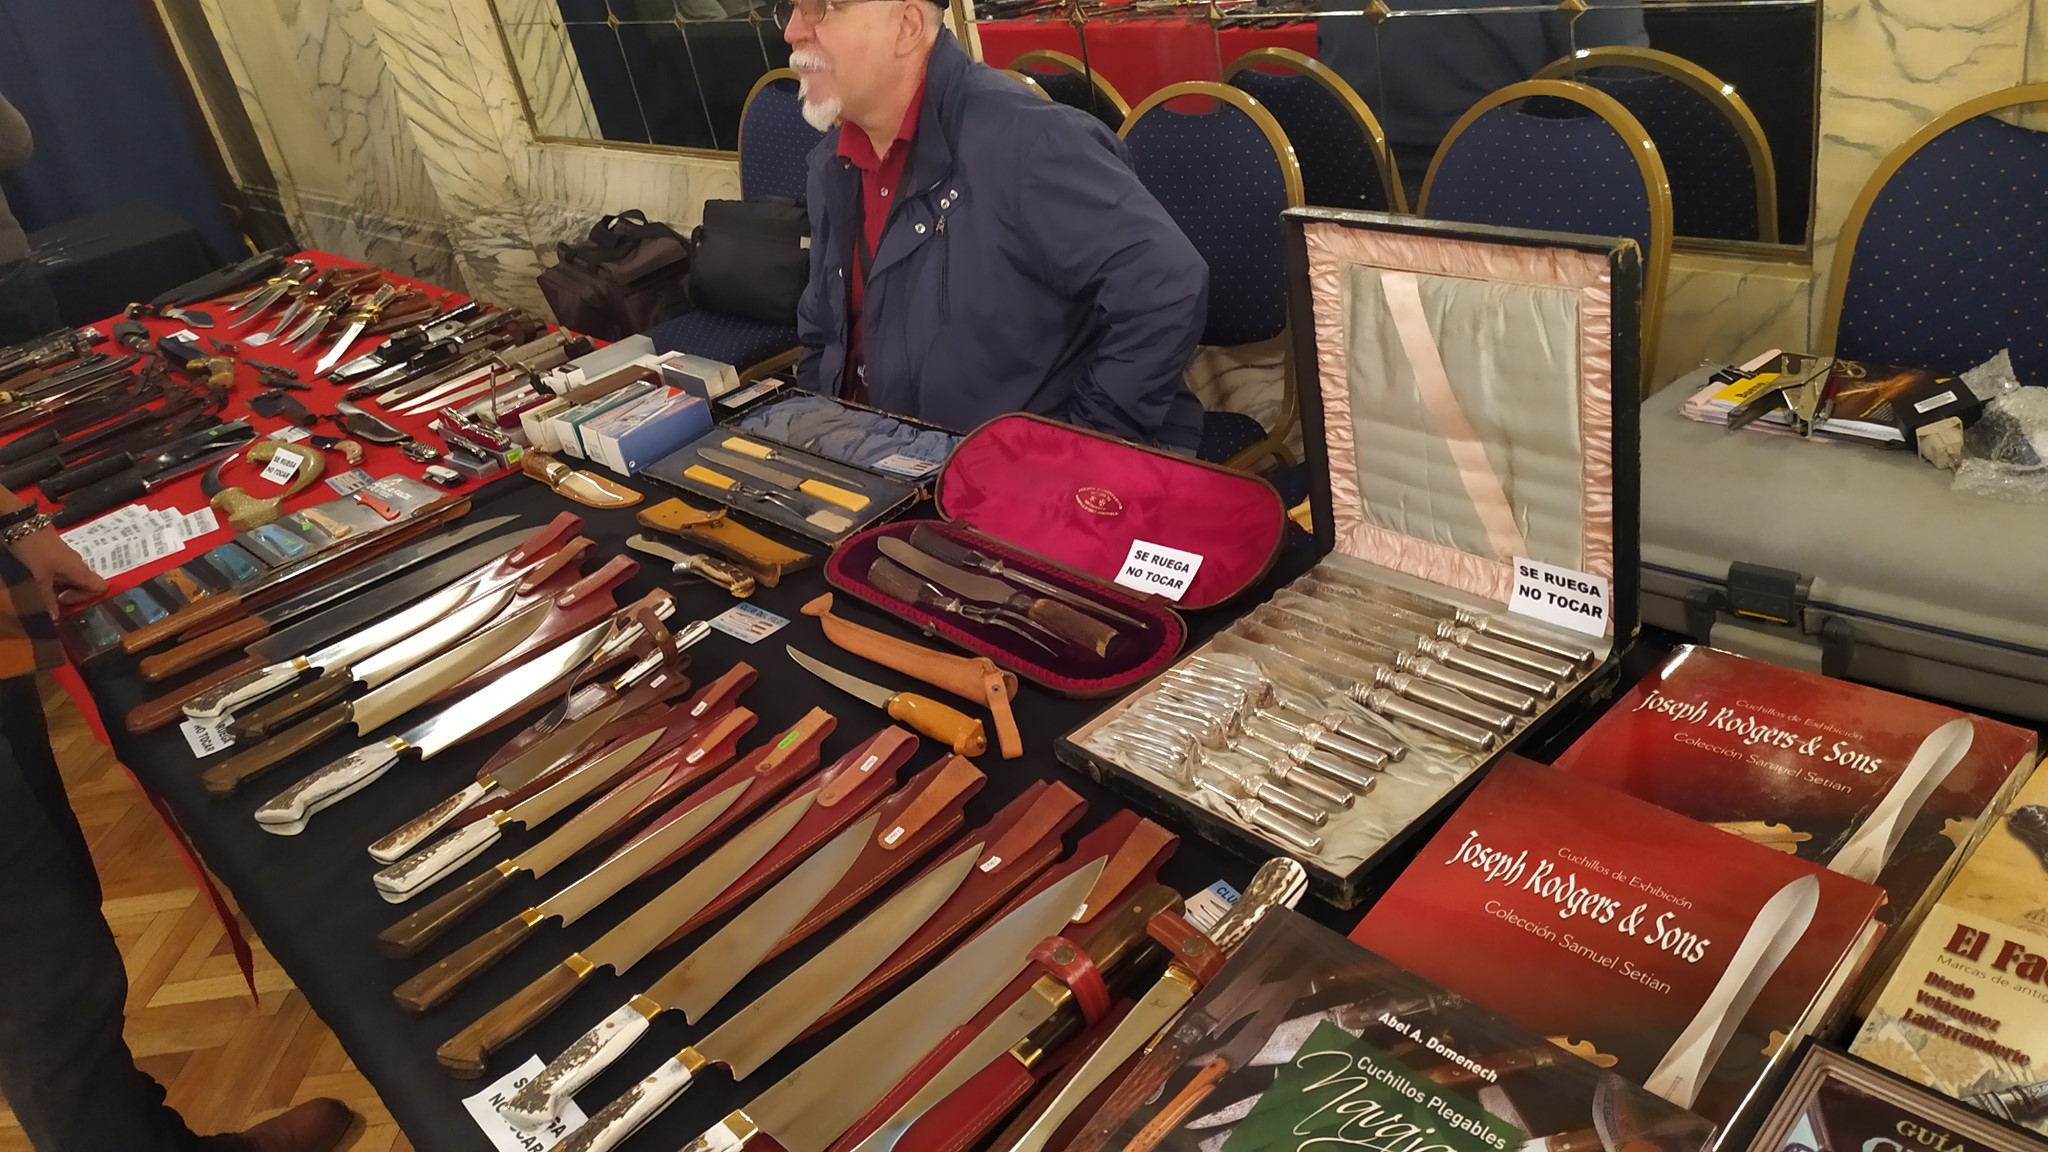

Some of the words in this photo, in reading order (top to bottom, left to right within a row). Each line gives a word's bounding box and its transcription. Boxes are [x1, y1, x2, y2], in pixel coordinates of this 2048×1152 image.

[1126, 566, 1143, 578] NO
[1145, 572, 1184, 590] TOCAR
[1134, 550, 1150, 562] SE
[1151, 555, 1190, 573] RUEGA
[1519, 565, 1539, 580] SE
[1544, 572, 1602, 598] RUEGA
[1519, 584, 1542, 601] NO
[1547, 592, 1603, 619] TOCAR
[1632, 690, 1709, 724] Joseph
[1708, 707, 1800, 749] Rodgers
[1799, 735, 1822, 757] &
[1824, 741, 1883, 775] Sons
[1736, 699, 1786, 719] Cuchillos
[1787, 713, 1802, 723] de
[1804, 718, 1864, 741] Exhibición
[1673, 733, 1743, 760] Colección
[1746, 754, 1802, 778] Samuel
[1804, 771, 1852, 794] Setian
[1216, 886, 1238, 906] CLU
[1445, 830, 1528, 887] Joseph
[1522, 859, 1621, 920] Rodgers
[1618, 904, 1648, 936] &
[1644, 912, 1711, 964] Sons
[1558, 847, 1610, 876] Cuchillos
[1611, 870, 1627, 883] de
[1628, 877, 1693, 910] Exhibición
[1485, 900, 1557, 942] Colección
[1559, 934, 1620, 969] Samuel
[1619, 961, 1672, 994] Setian
[1936, 954, 1986, 979] Marcas
[1991, 973, 2009, 988] de
[1943, 923, 1990, 962] El
[1991, 939, 2048, 986] Fa
[1924, 971, 1975, 1000] Diego
[1378, 1012, 1410, 1037] Abel
[1409, 1028, 1424, 1044] A.
[1426, 1036, 1498, 1083] Domenech
[1357, 1056, 1425, 1103] Cuchillos
[1426, 1096, 1506, 1150] Plegables
